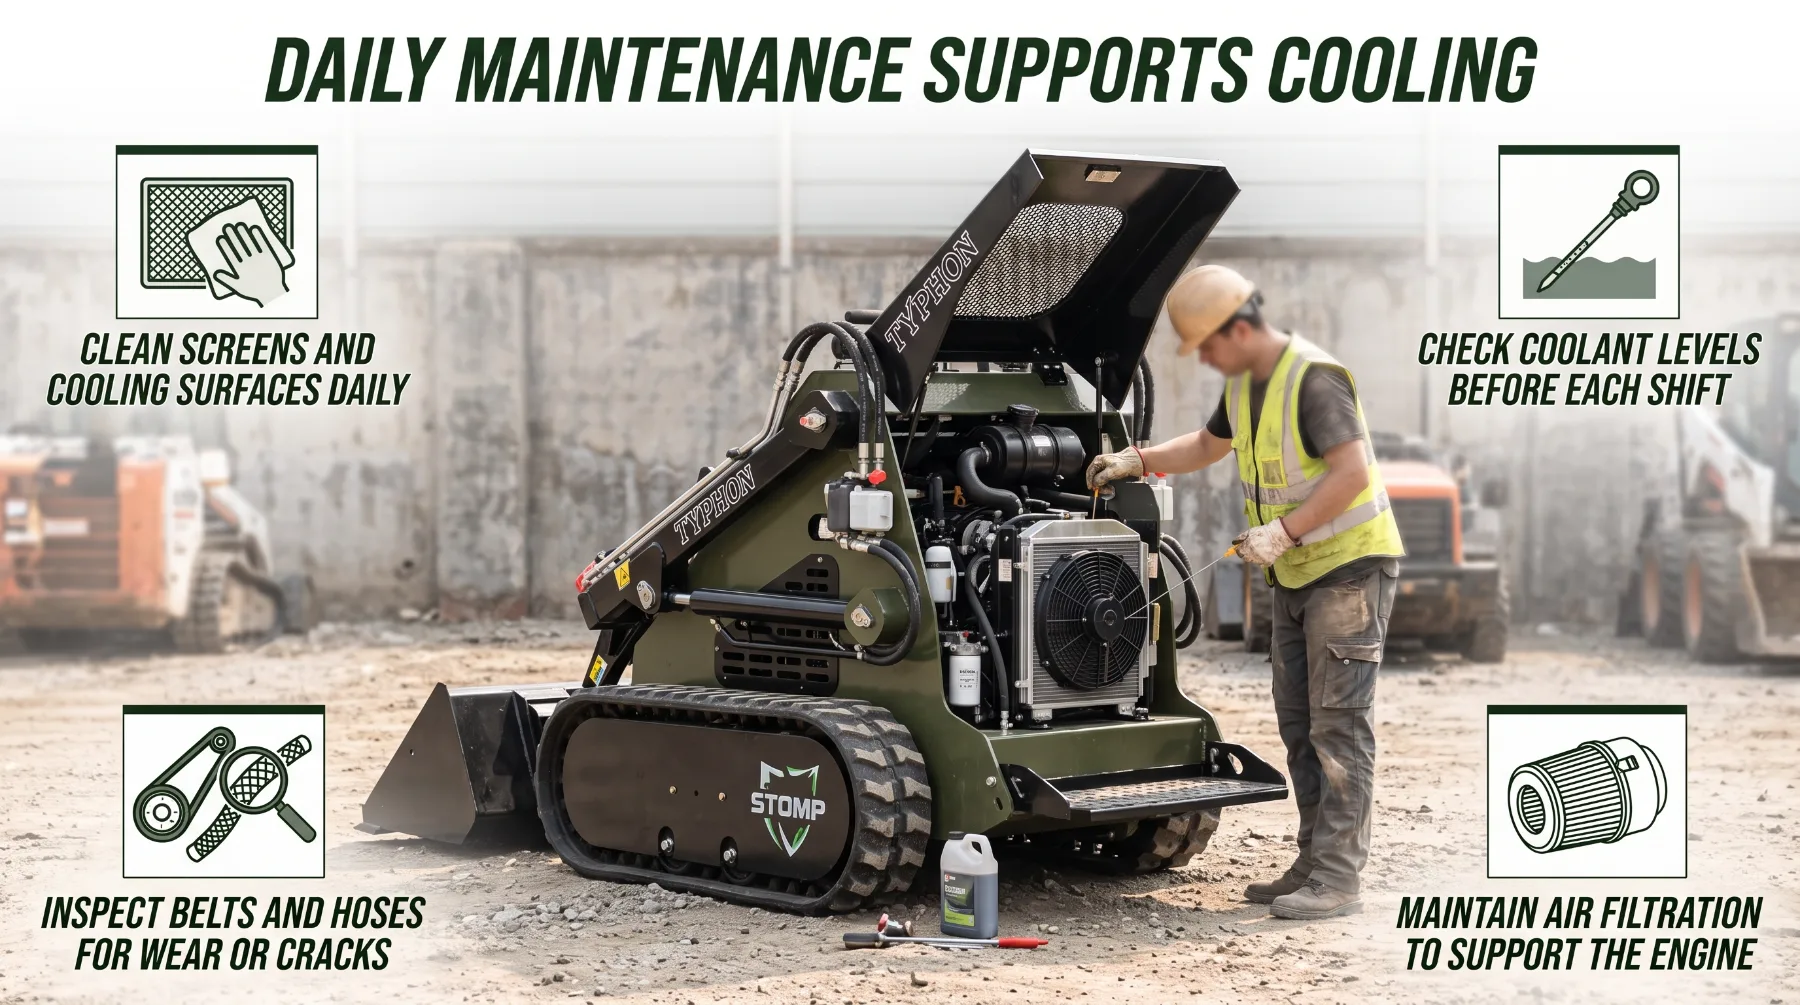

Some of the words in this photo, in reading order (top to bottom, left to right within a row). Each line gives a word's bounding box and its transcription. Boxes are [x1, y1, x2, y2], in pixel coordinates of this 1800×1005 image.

[884, 230, 979, 353] TYPHON
[673, 463, 756, 545] TYPHON
[750, 791, 826, 821] STOMP
